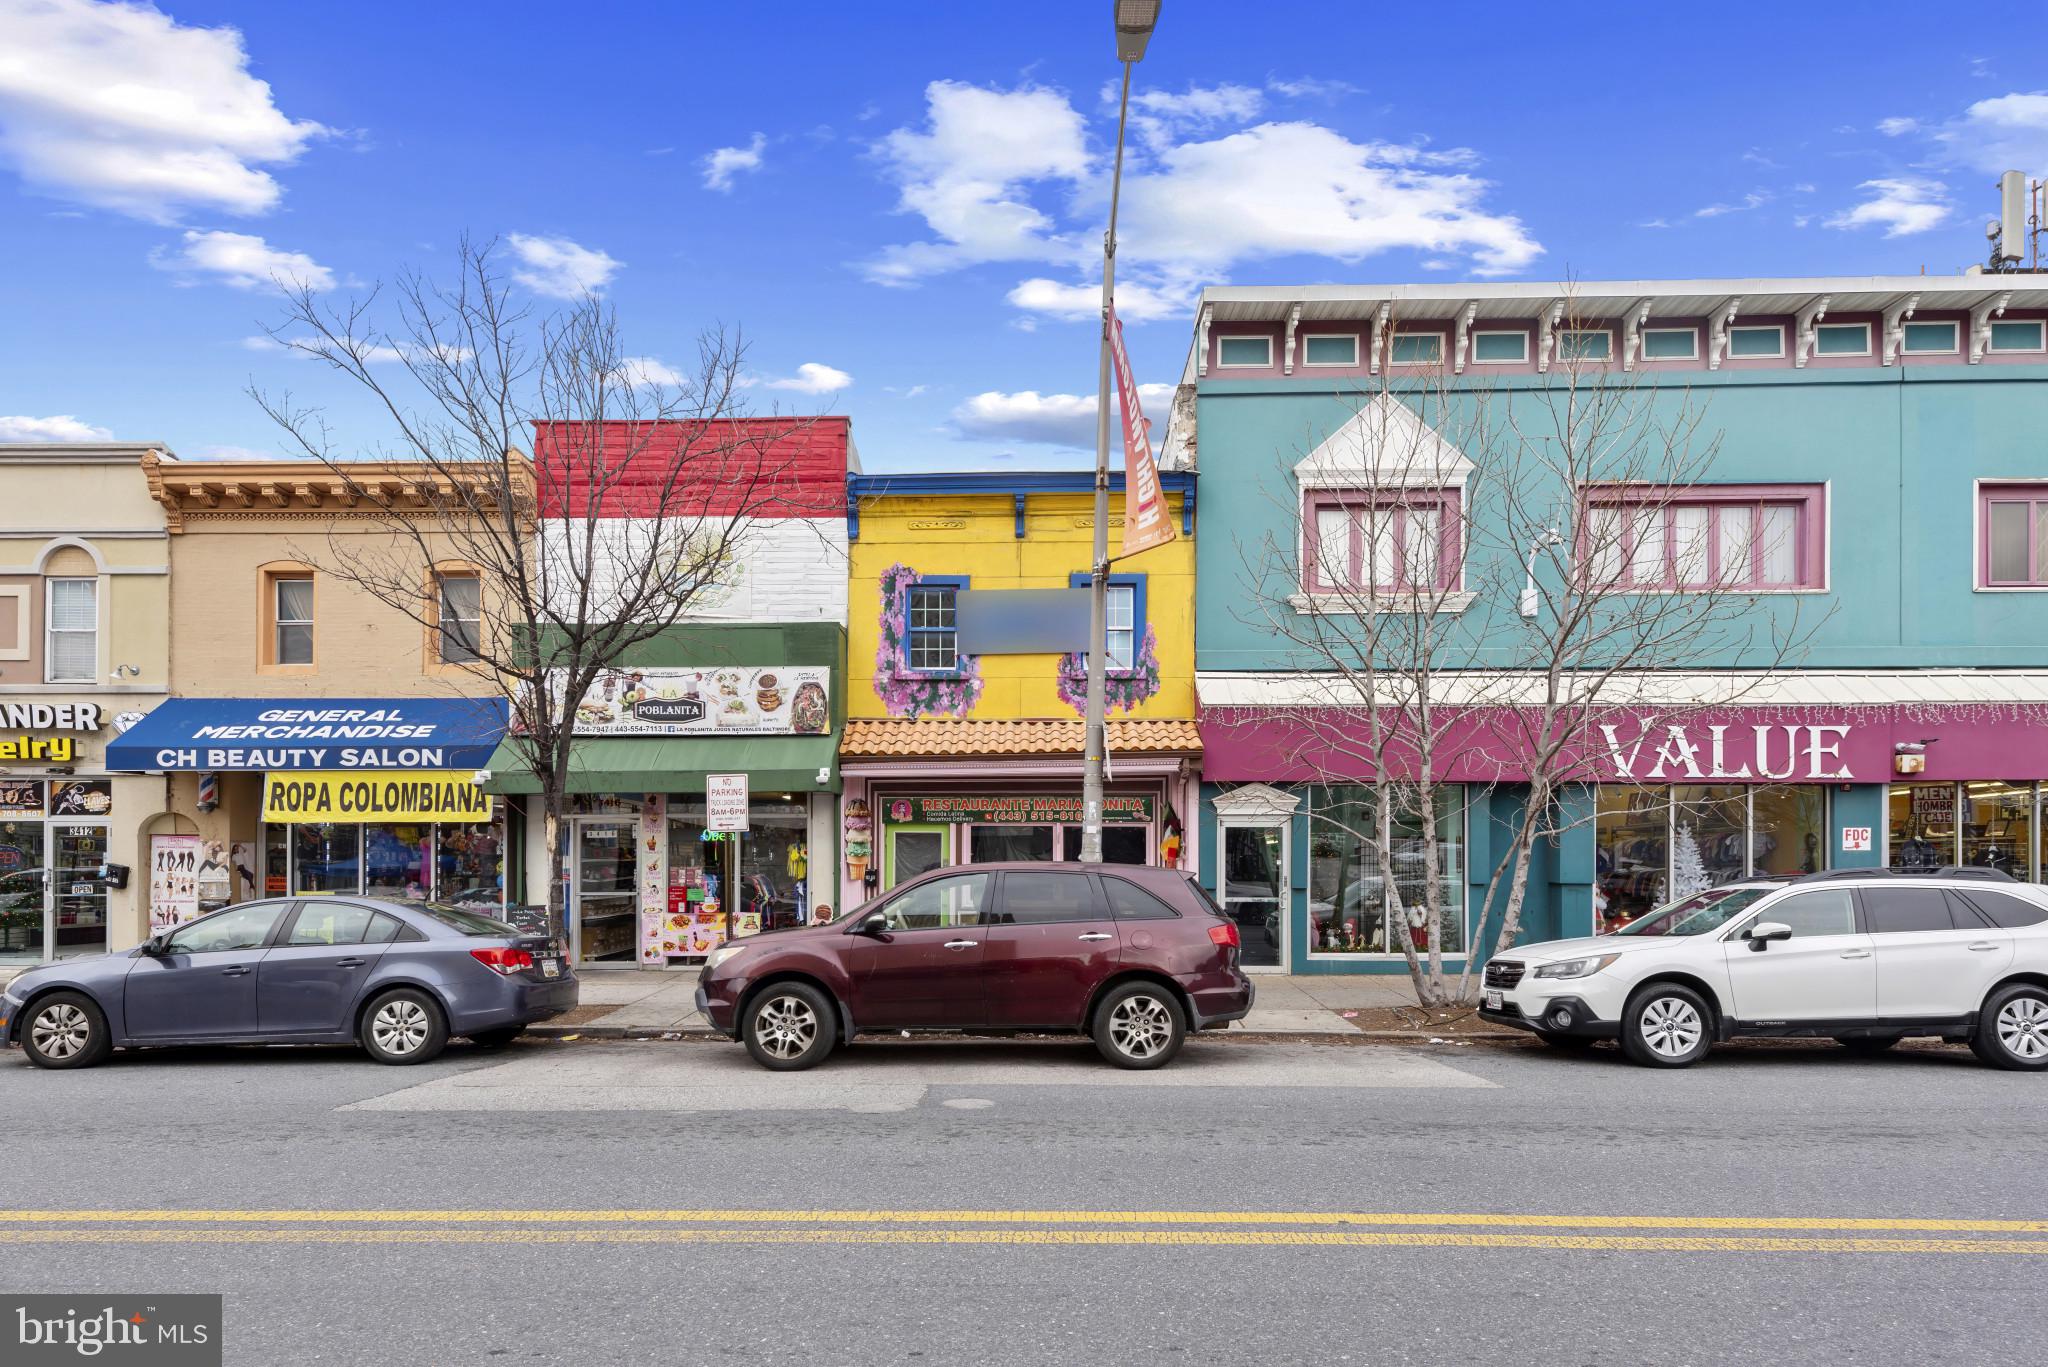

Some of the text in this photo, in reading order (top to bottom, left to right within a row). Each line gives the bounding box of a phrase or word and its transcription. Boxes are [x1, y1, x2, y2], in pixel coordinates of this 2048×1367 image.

[258, 709, 404, 722] GENERAL
[638, 705, 700, 716] POBLANITA
[192, 725, 438, 739] MERCHANDISE
[0, 736, 71, 761] elry
[1598, 724, 1855, 780] VALUE
[156, 748, 443, 767] CH BEAUTY SALON
[722, 778, 732, 786] NO
[269, 781, 488, 813] ROPA COLOMBIANA
[711, 788, 744, 797] PARKING
[922, 798, 1030, 811] RESTAURANTE
[1034, 798, 1083, 811] MARIA
[710, 807, 746, 816] 8AM-6PM
[993, 811, 1027, 822] (443)
[70, 826, 93, 836] 3412
[1845, 829, 1869, 841] FDC
[74, 885, 93, 894] OPEN
